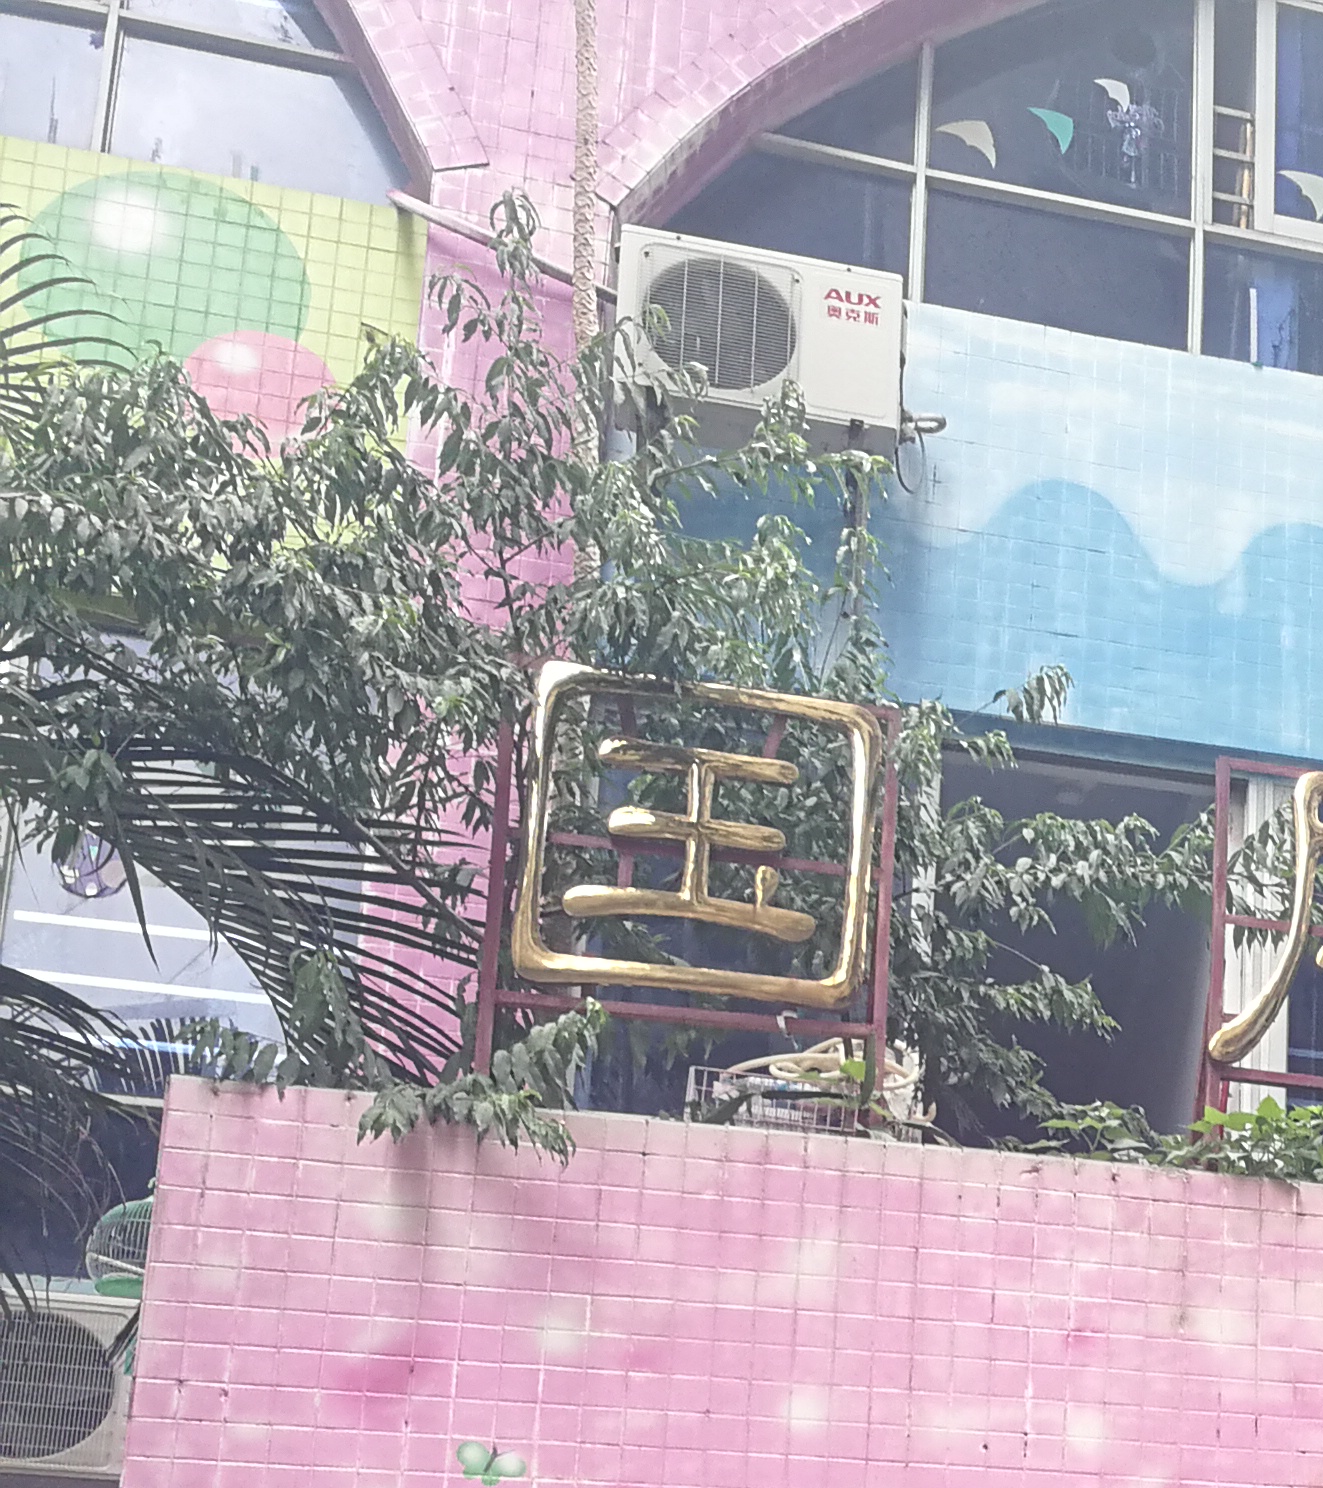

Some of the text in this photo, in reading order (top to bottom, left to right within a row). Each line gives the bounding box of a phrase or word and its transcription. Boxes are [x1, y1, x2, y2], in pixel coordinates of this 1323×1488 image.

[824, 288, 881, 309] AUX
[827, 305, 880, 327] 奥克斯
